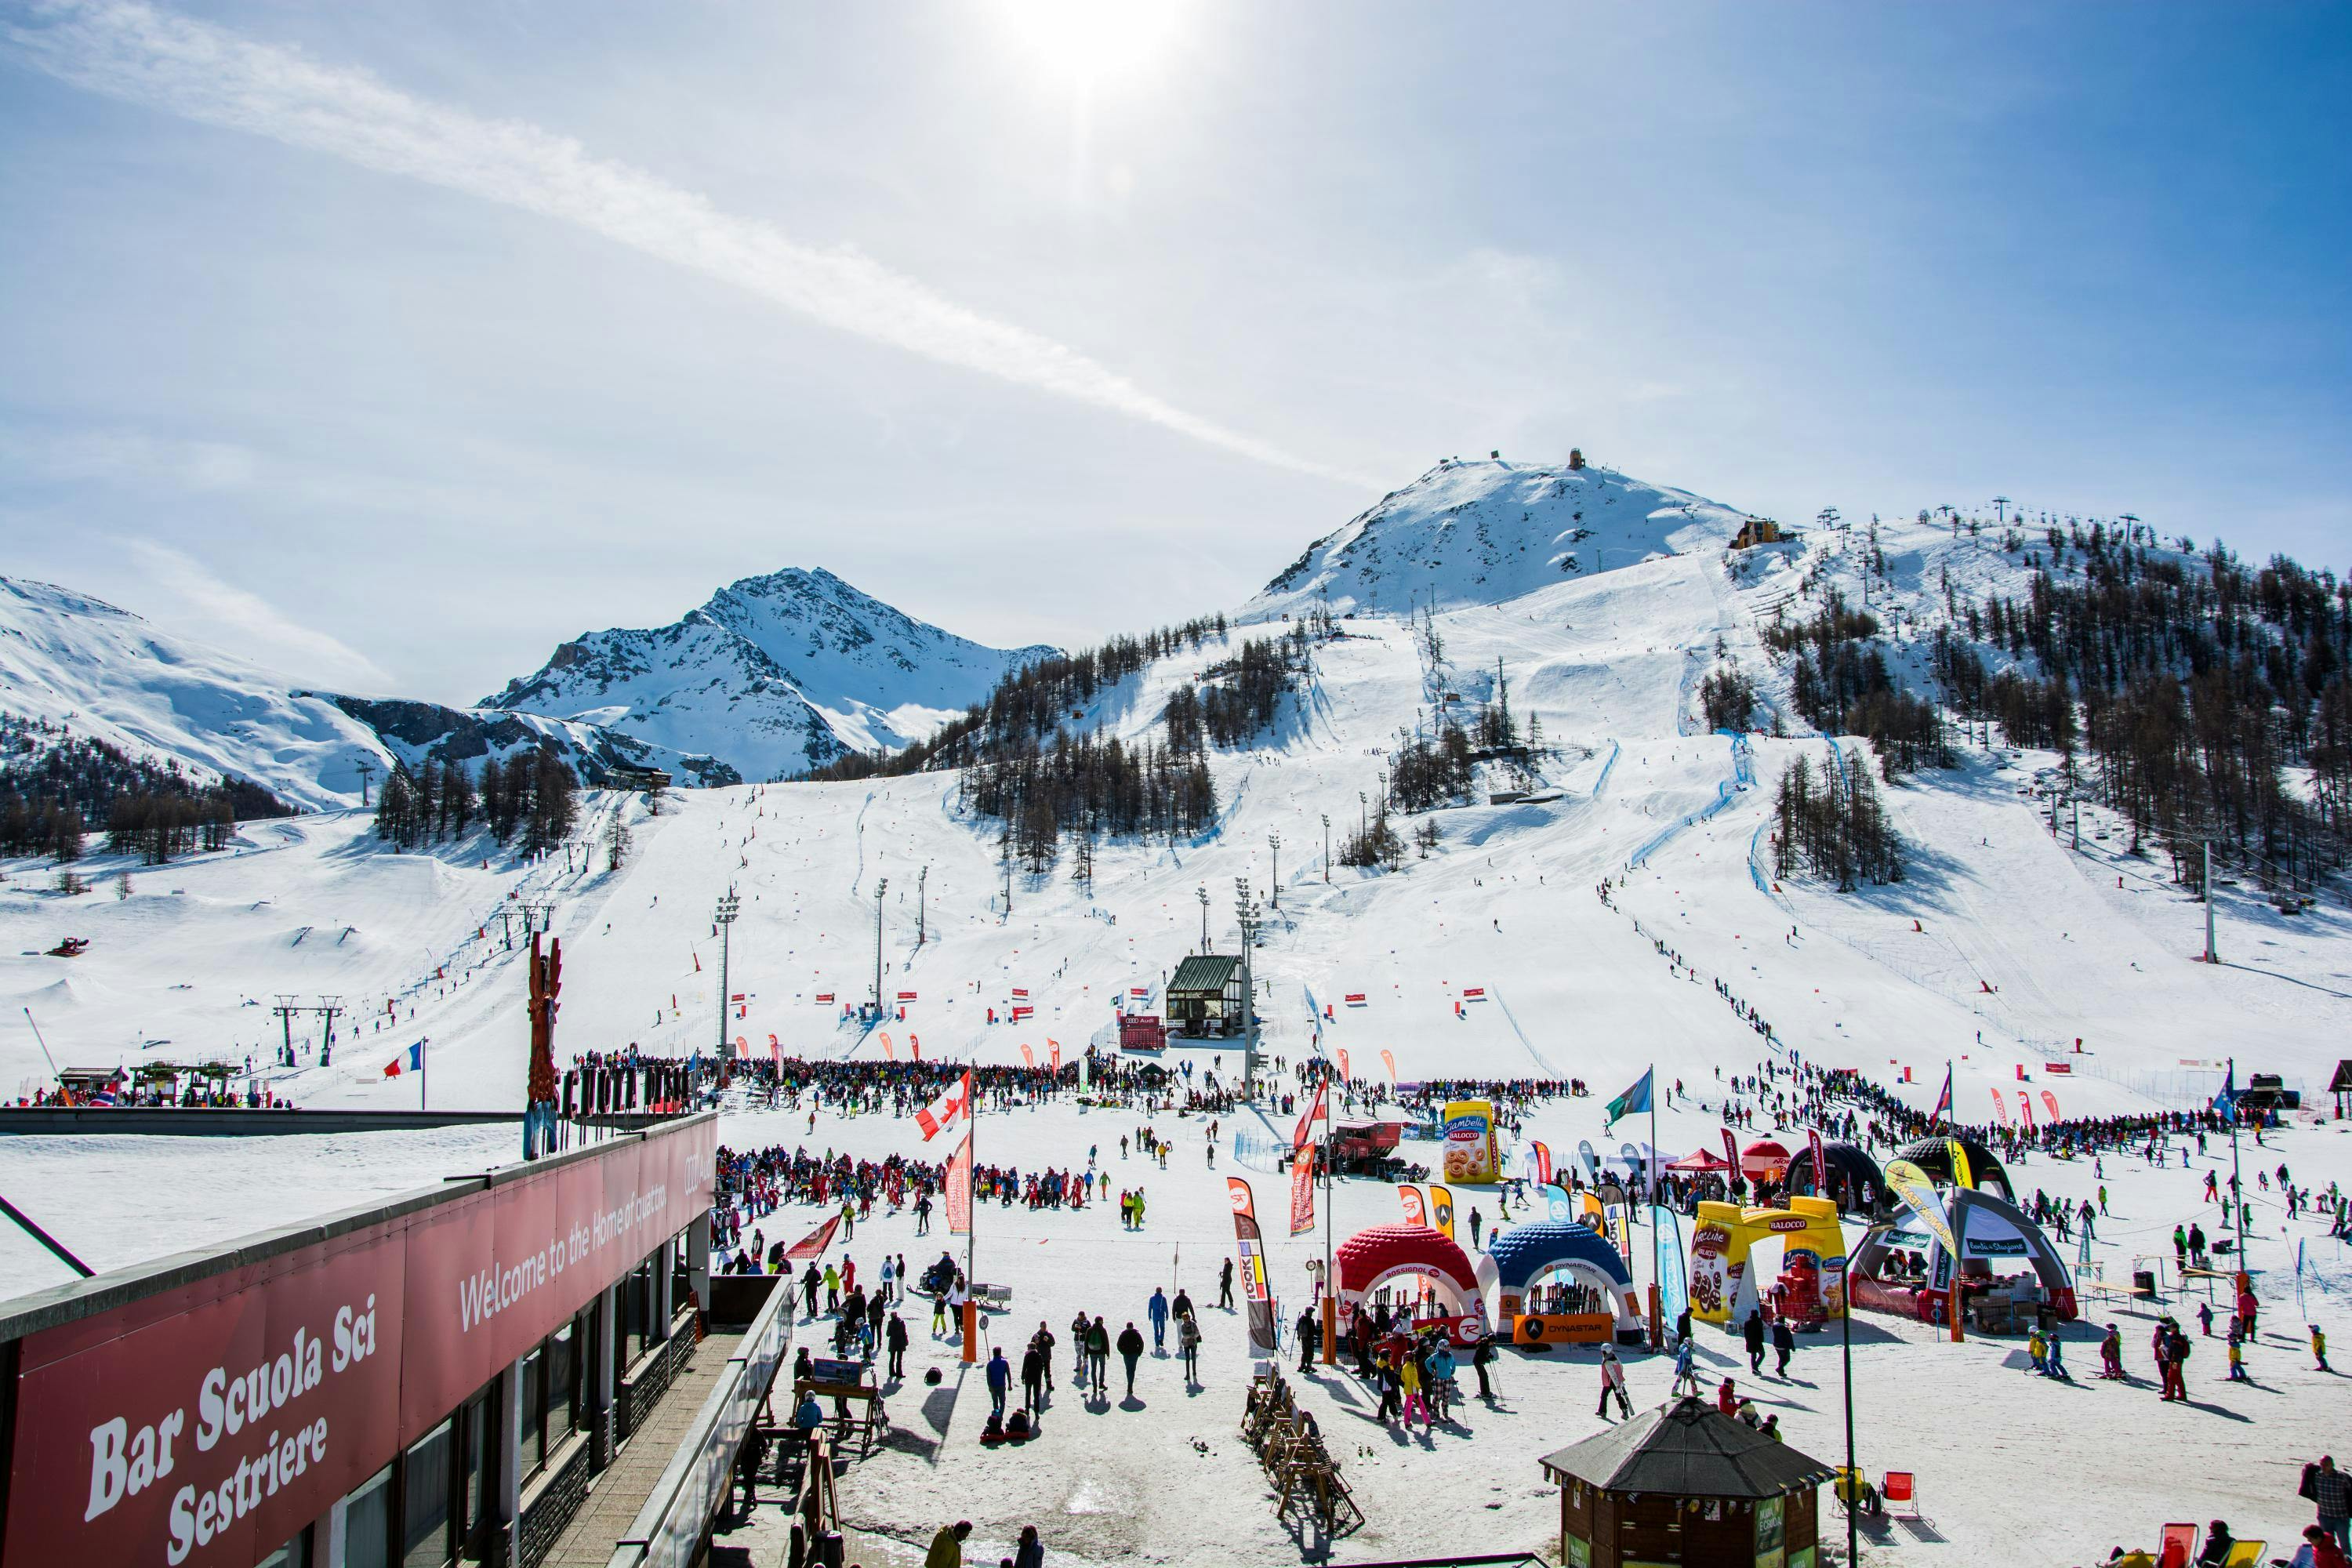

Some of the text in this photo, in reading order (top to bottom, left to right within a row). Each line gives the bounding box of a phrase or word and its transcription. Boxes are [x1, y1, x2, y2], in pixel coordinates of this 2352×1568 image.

[1444, 1116, 1485, 1134] Ciambelle
[1490, 1132, 1498, 1174] BALOCCO
[698, 1151, 713, 1185] Audi
[1769, 1220, 1806, 1230] BALOCCO
[460, 1250, 546, 1332] Welcome
[550, 1239, 565, 1277] to
[569, 1221, 589, 1265] the
[593, 1209, 622, 1250] Home
[625, 1191, 636, 1225] of
[1386, 1267, 1427, 1279] ROSSIGNOL
[1555, 1262, 1597, 1274] DYNASTAR
[1548, 1323, 1602, 1333] DYNASTAR
[84, 1293, 376, 1523] Bar Scuola Sci
[167, 1417, 328, 1566] Sestriere
